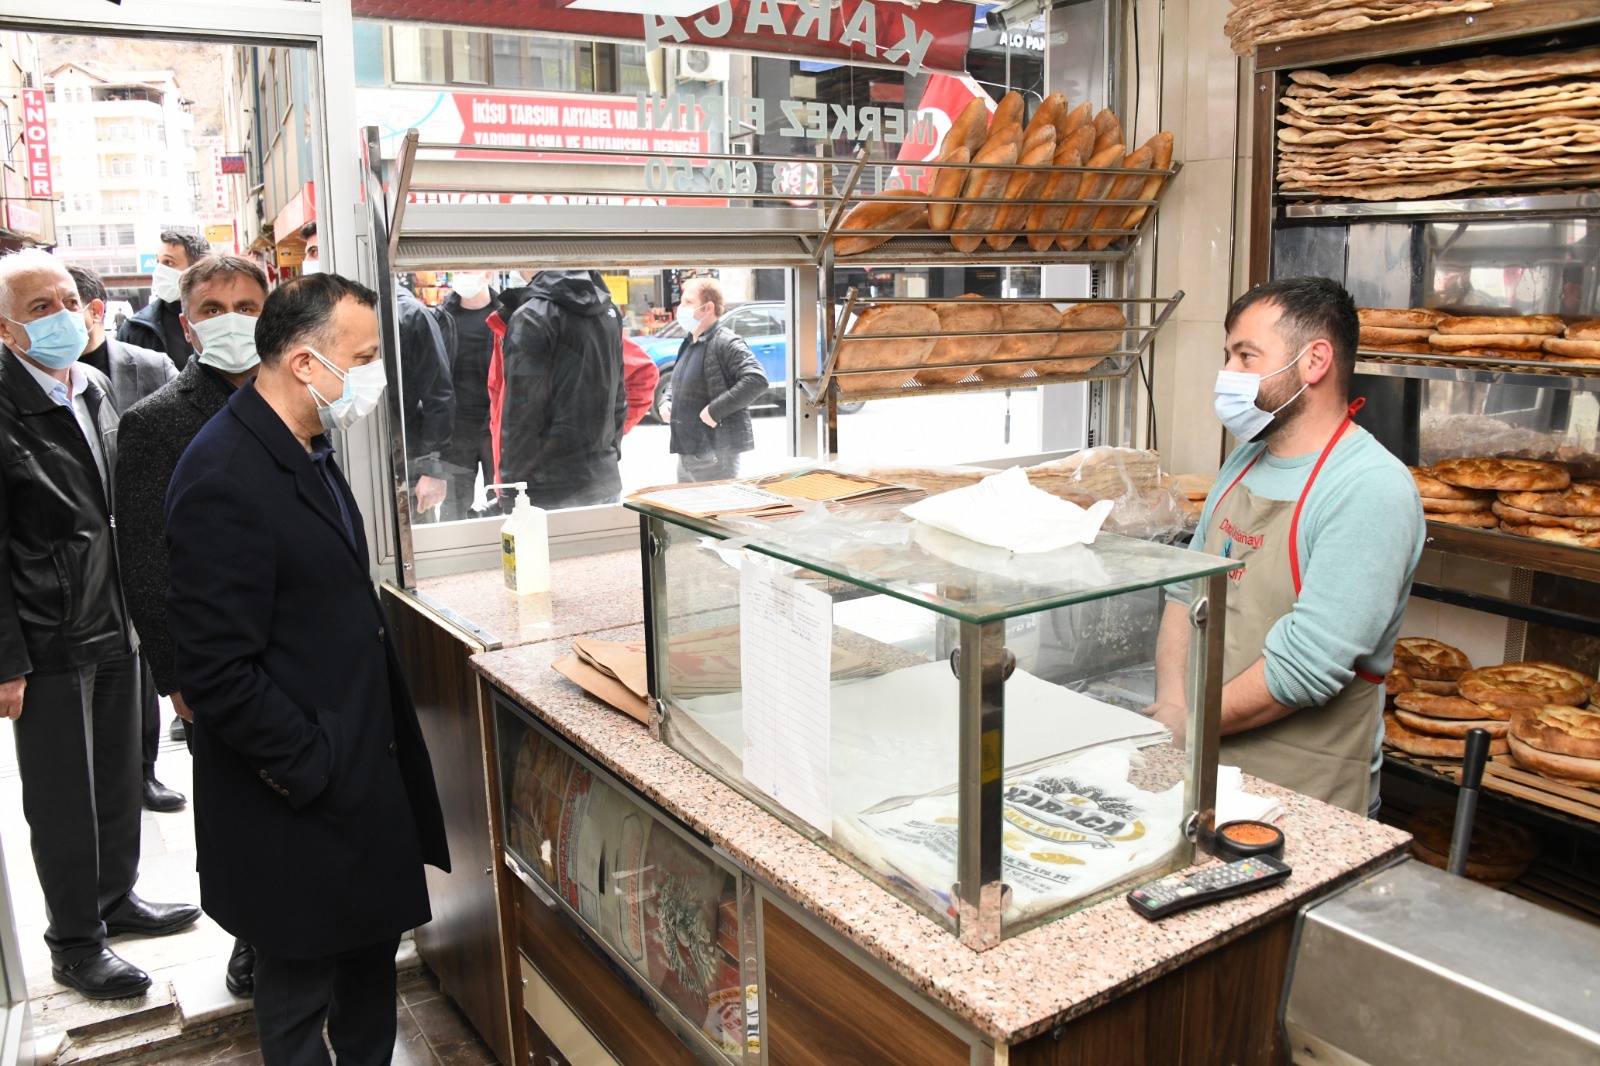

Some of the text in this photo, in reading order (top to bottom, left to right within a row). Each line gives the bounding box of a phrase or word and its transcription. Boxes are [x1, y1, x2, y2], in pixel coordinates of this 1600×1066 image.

[472, 98, 506, 125] İKİSU
[509, 104, 559, 127] TARSUN
[562, 107, 613, 129] ARTABEL
